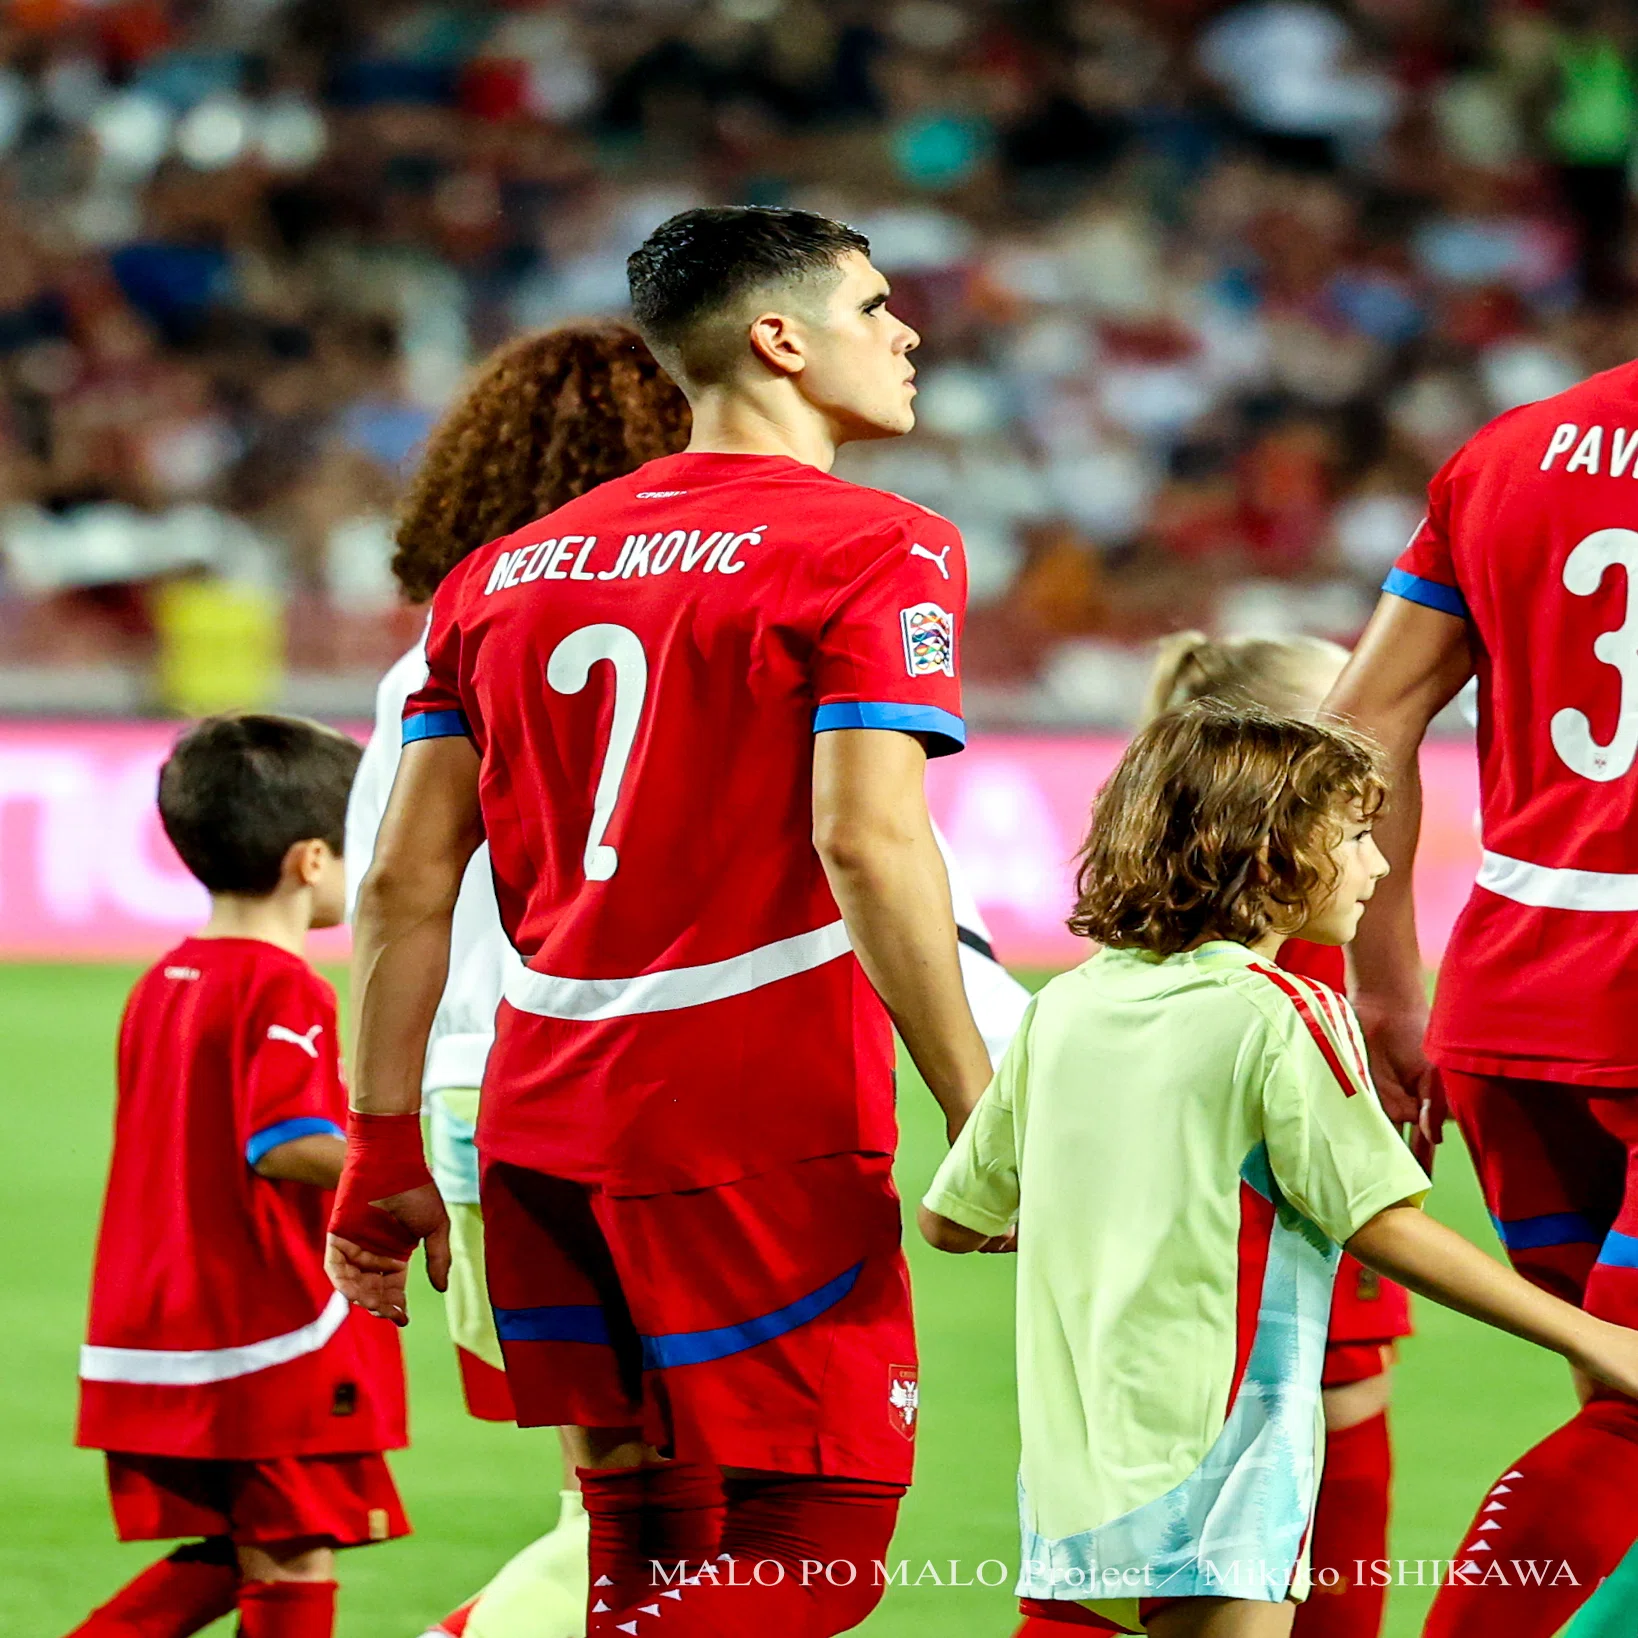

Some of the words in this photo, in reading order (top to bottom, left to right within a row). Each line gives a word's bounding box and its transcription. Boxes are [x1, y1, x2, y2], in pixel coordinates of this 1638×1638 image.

[1540, 423, 1638, 479] PAV
[484, 525, 768, 596] NEDELJKOVIĆ
[1550, 527, 1638, 783] 3
